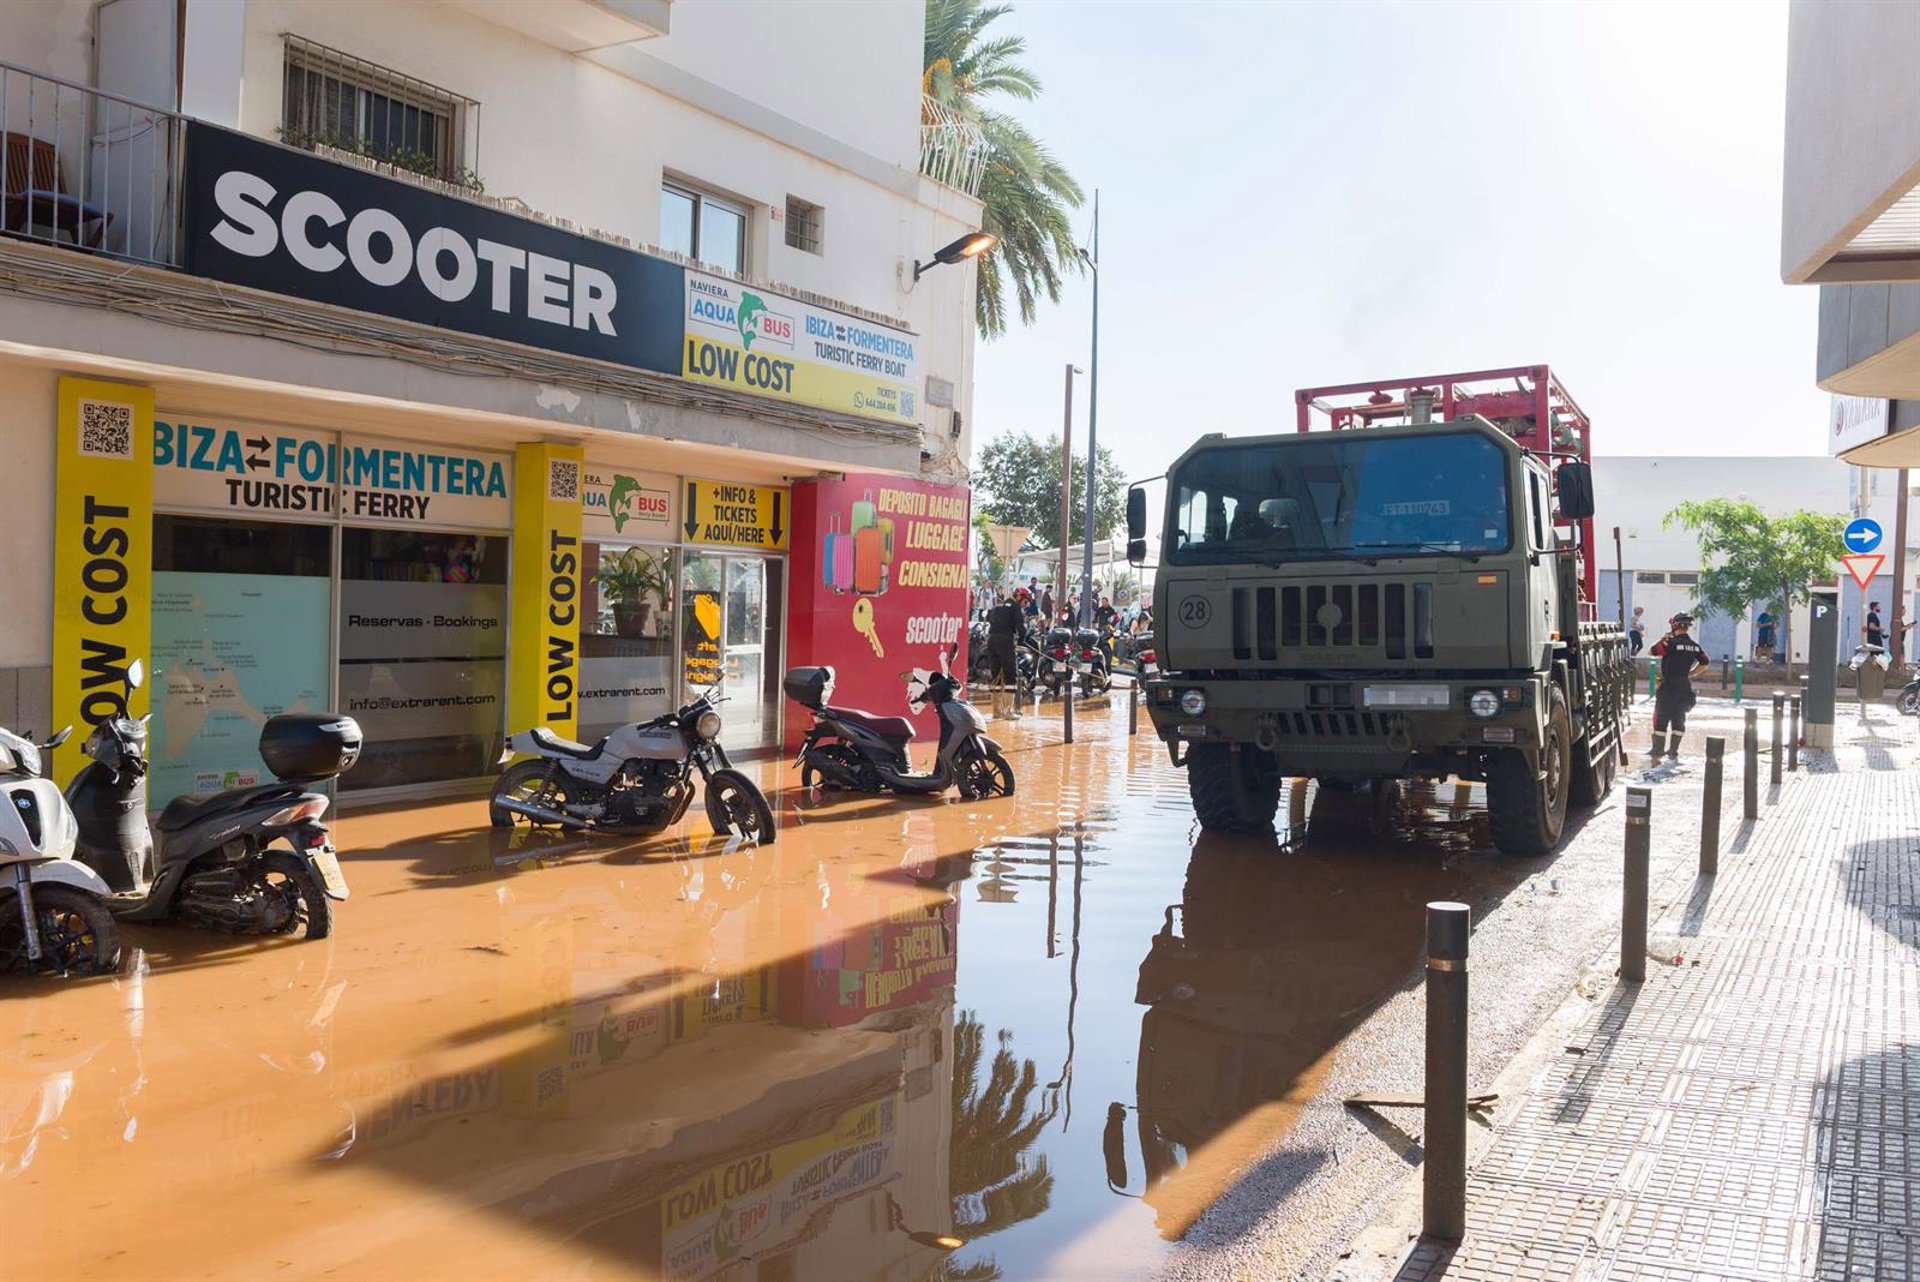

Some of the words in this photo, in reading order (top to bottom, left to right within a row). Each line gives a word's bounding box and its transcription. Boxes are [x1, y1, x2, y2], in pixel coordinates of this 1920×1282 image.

[210, 171, 618, 337] SCOOTER
[690, 279, 729, 298] NAVIERA
[693, 298, 736, 325] AQUA
[763, 317, 791, 339] BUS
[805, 315, 835, 340] IBIZA
[847, 326, 914, 361] FORMENTERA
[688, 340, 739, 382] LOW
[743, 353, 795, 393] COST
[814, 341, 855, 365] TURISTIC
[856, 352, 884, 373] FERRY
[885, 360, 906, 377] BOAT
[153, 420, 247, 474] BIZA
[275, 437, 507, 498] FORMENTERA
[354, 490, 431, 520] FERRY
[638, 496, 667, 512] BUS
[713, 486, 747, 503] +INFO
[748, 488, 756, 505] &
[878, 488, 927, 517] DEPOSITO
[928, 494, 967, 521] BAGAGLI
[714, 504, 757, 524] TICKETS
[704, 522, 765, 544] AQUÍ/HERE
[905, 520, 966, 552] LUGGAGE
[81, 495, 129, 625] COST
[898, 560, 967, 589] CONSIGNA
[549, 529, 577, 626] COST
[348, 615, 424, 628] Reservas
[433, 615, 499, 630] Bookings
[1184, 601, 1206, 621] 28
[1816, 605, 1828, 618] P
[905, 611, 963, 645] scooter
[546, 635, 575, 722] LOW
[80, 638, 128, 754] OW
[350, 693, 496, 711] info@extrarent.com
